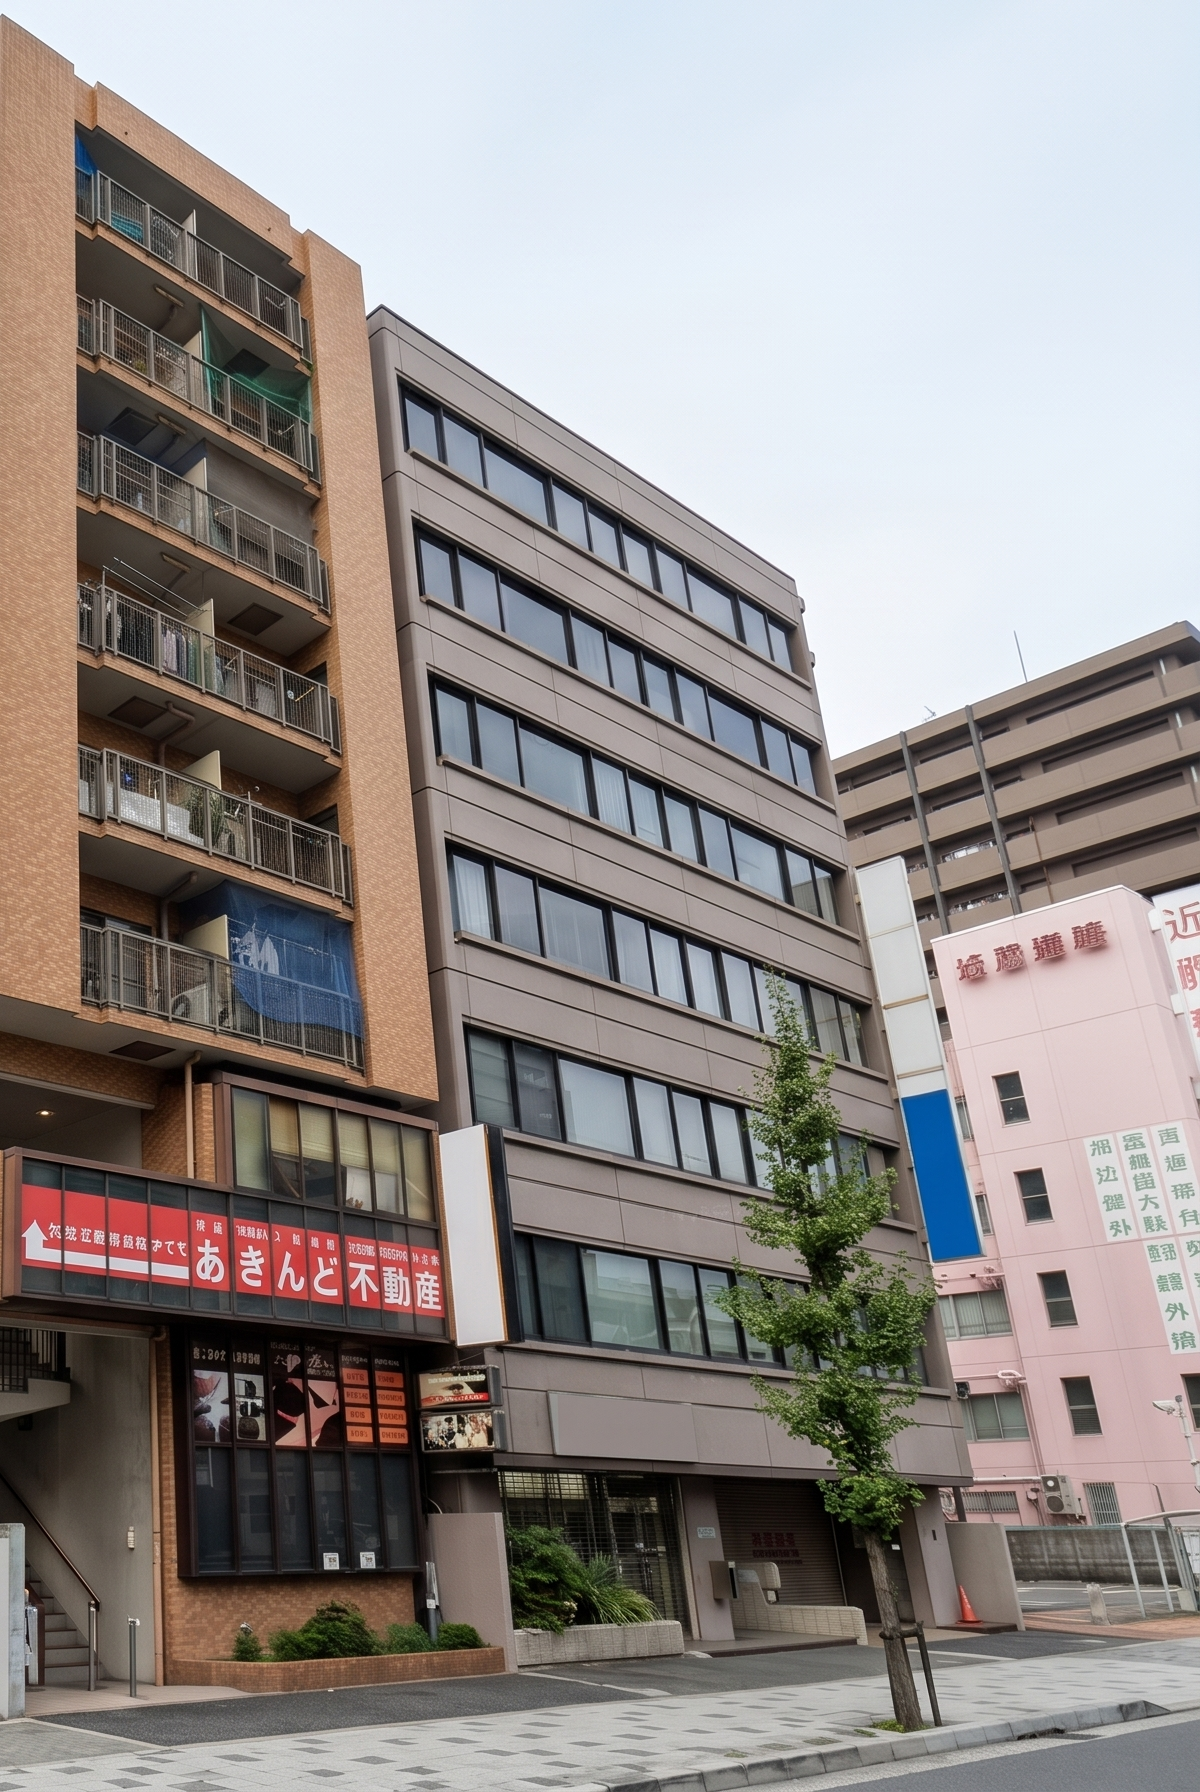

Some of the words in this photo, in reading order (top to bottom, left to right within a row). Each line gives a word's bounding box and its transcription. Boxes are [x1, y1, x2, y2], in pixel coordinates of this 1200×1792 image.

[196, 1239, 442, 1311] あきんど不動産
